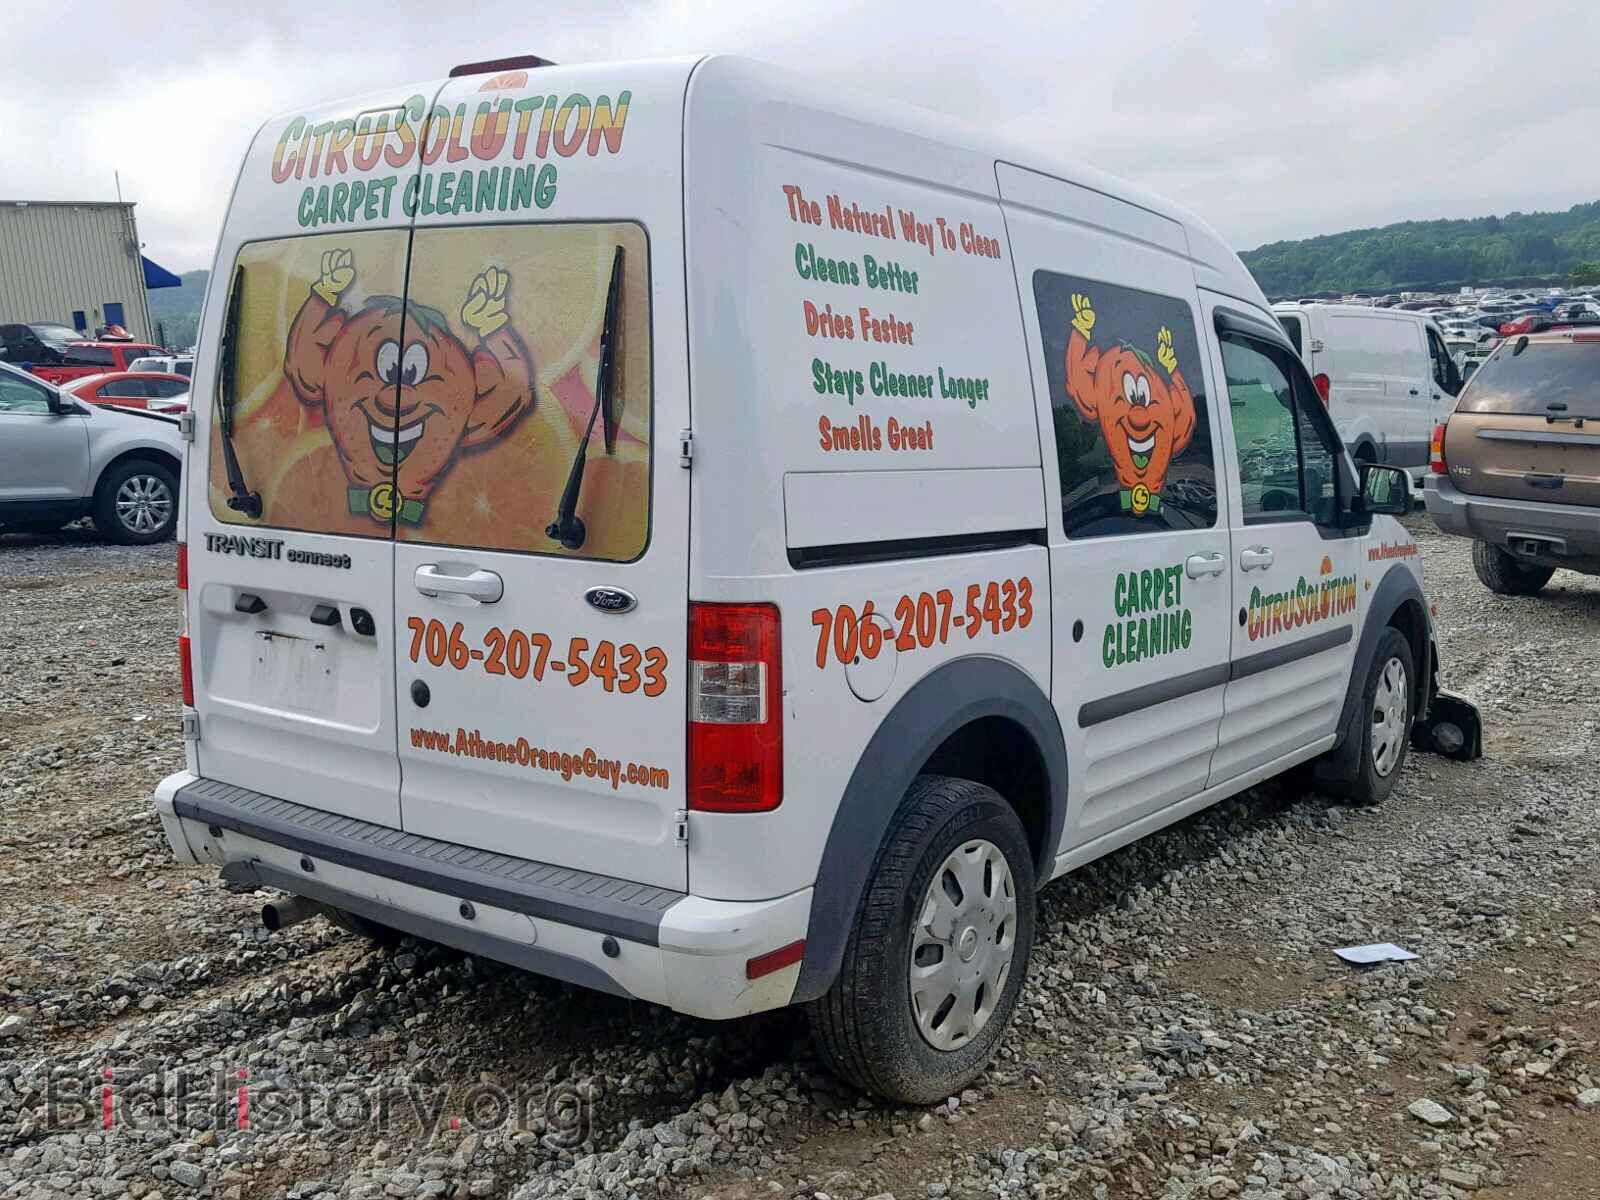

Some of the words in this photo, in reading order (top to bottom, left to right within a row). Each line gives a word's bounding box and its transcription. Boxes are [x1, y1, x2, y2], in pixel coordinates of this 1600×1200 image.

[298, 176, 397, 227] CARPET
[402, 164, 557, 218] CLEANING
[783, 185, 822, 226] The
[826, 195, 896, 240] Natural
[898, 209, 934, 256] Way
[936, 218, 956, 251] To
[960, 223, 1001, 260] Clean
[794, 242, 859, 286] Cleans
[863, 254, 919, 295] Better
[803, 300, 854, 340] Dries
[858, 307, 914, 346] Faster
[811, 357, 865, 405] Stays
[868, 361, 934, 399] Cleaner
[938, 366, 989, 409] Longer
[818, 415, 882, 452] Smells
[887, 416, 934, 451] Great
[204, 532, 285, 560] TRANSIT
[286, 549, 352, 569] connect
[593, 590, 624, 607] Ford
[1114, 564, 1183, 617] CARPET
[811, 576, 1034, 671] 706-207-5433
[1102, 608, 1192, 669] CLEANING
[407, 616, 669, 697] 706-207-5433
[410, 727, 670, 791] www.AthensOrangeGuy.com
